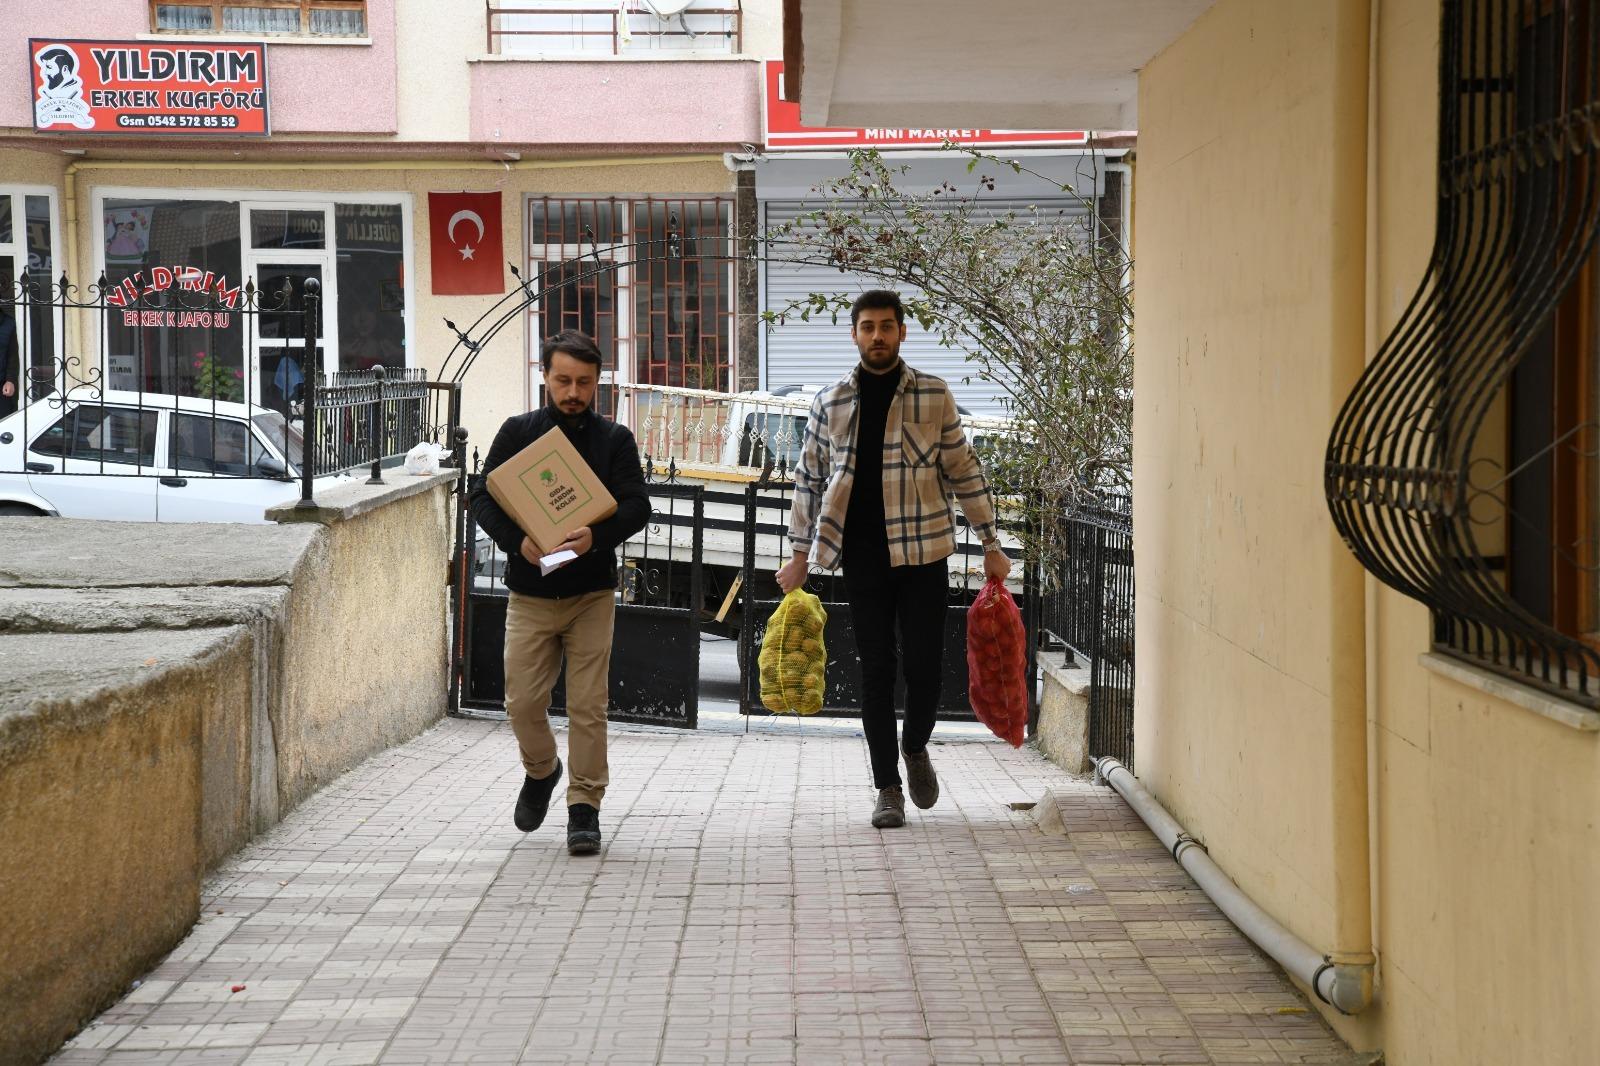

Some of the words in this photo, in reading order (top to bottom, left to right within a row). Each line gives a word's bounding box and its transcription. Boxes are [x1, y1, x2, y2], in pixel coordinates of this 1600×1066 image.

[90, 48, 258, 85] YILDIRIM
[90, 90, 160, 109] ERKEK
[166, 88, 264, 110] KUAFÖRÜ
[119, 115, 145, 126] Gsm
[147, 115, 177, 127] 0542
[179, 116, 201, 127] 572
[203, 116, 218, 127] 85
[221, 116, 236, 127] 52
[123, 310, 164, 327] ERKEK
[549, 485, 565, 497] GIDA
[549, 487, 574, 506] YARDIM
